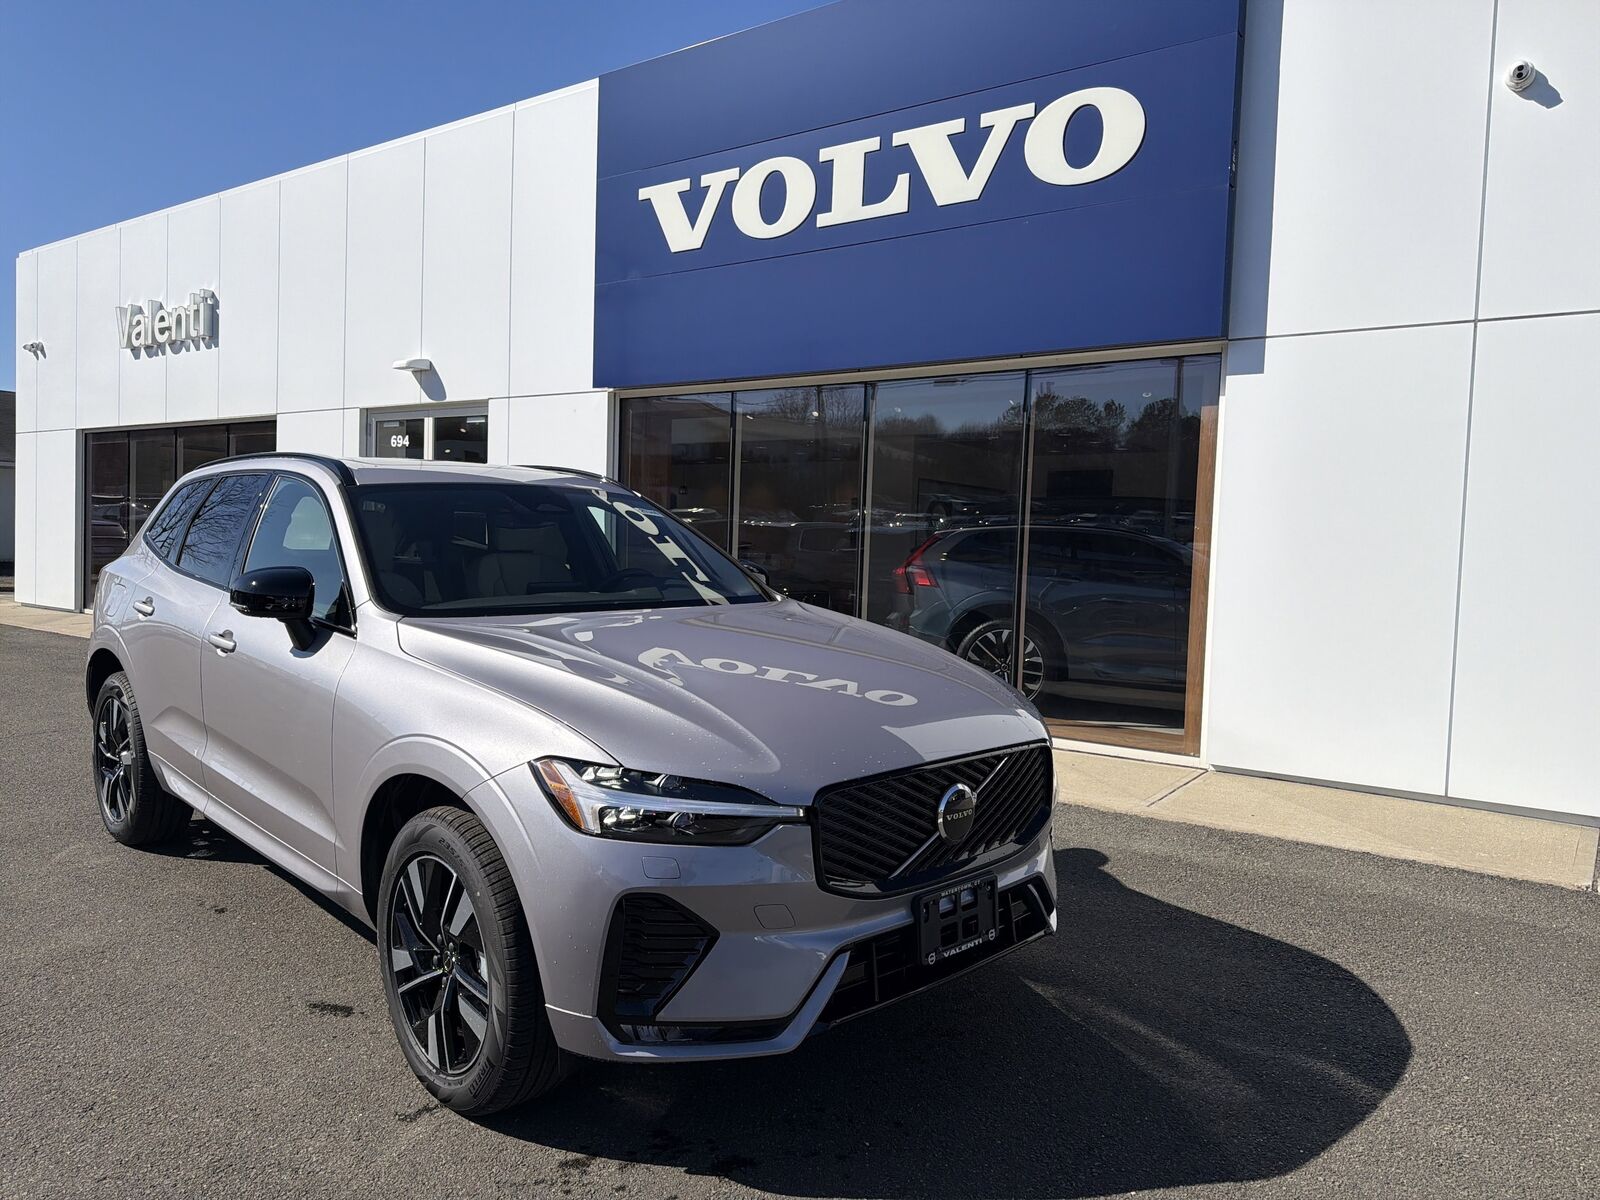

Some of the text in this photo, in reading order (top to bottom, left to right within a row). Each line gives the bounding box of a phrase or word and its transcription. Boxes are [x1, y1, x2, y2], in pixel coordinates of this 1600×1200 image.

[638, 87, 1146, 252] VOLVO
[115, 289, 212, 349] Valenti
[390, 435, 410, 448] 694
[946, 809, 973, 821] VOLVO
[943, 938, 983, 957] VALENTI
